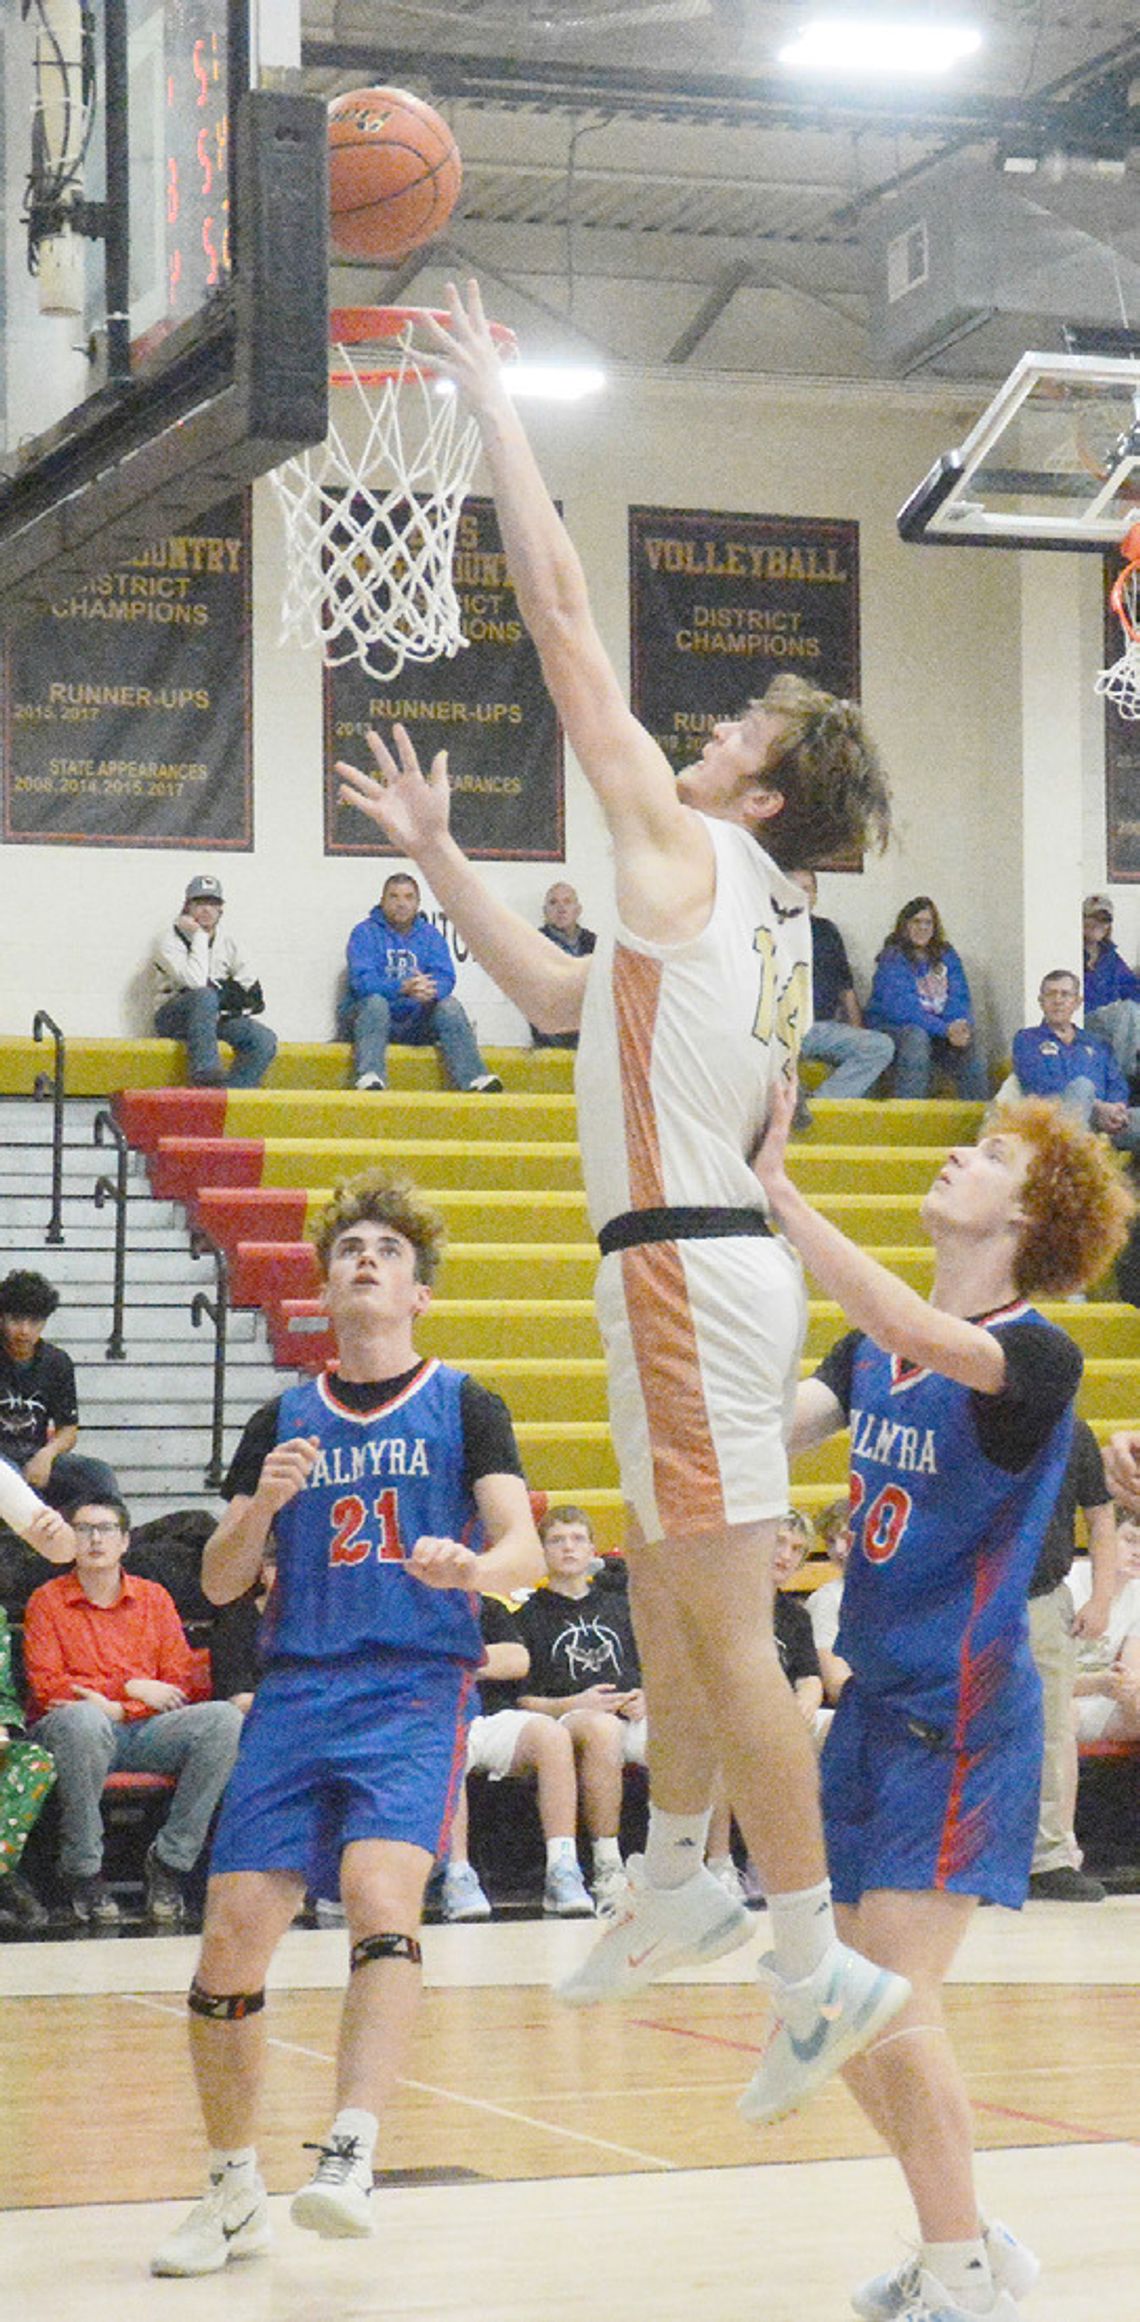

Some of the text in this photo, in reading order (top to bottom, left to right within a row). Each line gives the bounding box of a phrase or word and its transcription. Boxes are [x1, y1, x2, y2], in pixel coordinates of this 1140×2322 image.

[645, 537, 848, 584] VOLLEYBALL
[694, 605, 802, 632] DISTRICT
[676, 629, 821, 658] CHAMPIONS
[51, 682, 210, 710] RUNNER-UPS
[370, 699, 523, 724] RUNNER-UPS
[50, 757, 208, 781] STATE APPEARANCES
[328, 1487, 412, 1568] 21
